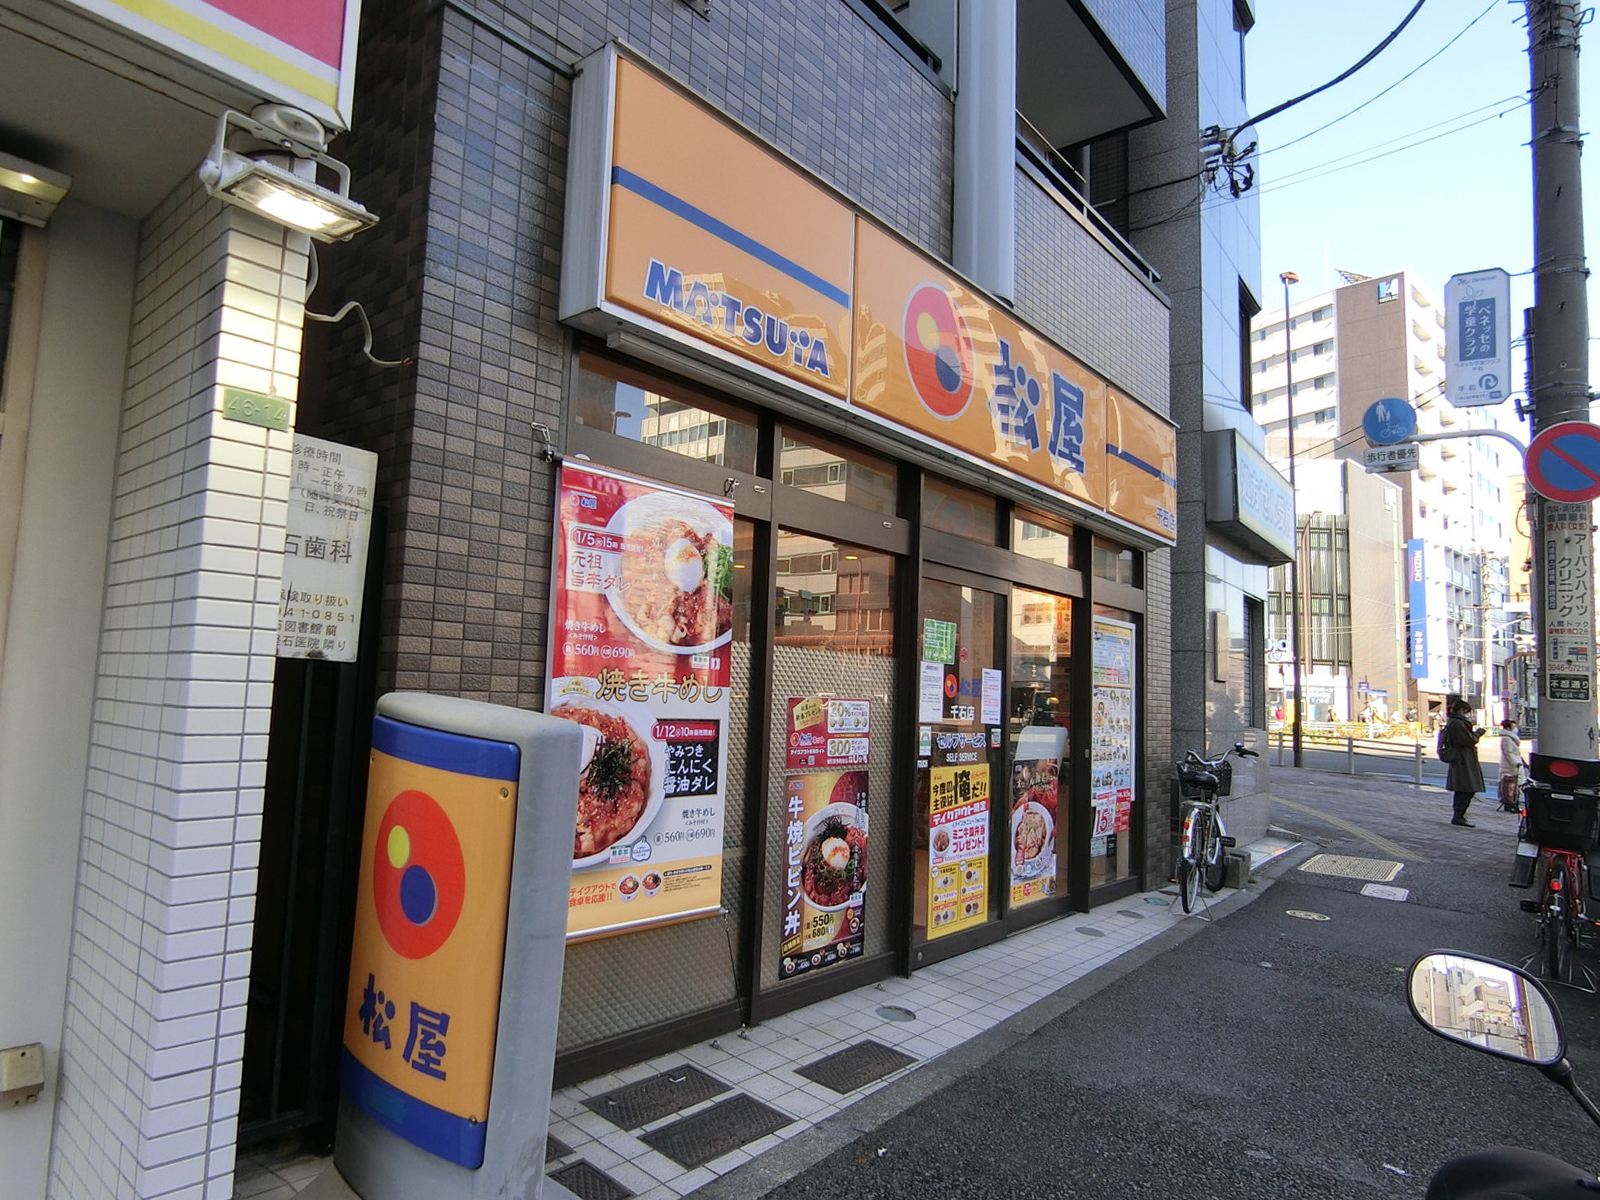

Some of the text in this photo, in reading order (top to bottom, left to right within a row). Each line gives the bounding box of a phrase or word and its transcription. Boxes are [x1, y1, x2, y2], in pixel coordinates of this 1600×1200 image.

[643, 257, 830, 378] MATSUYA
[1464, 305, 1477, 358] 学童クラブ
[1478, 305, 1491, 352] ベネッセの
[228, 396, 288, 424] 46-14
[986, 335, 1085, 476] 松屋
[1367, 448, 1417, 463] 歩行者優先
[286, 533, 352, 564] 石歯科
[571, 551, 603, 570] 元祖
[571, 569, 632, 592] 旨辛ダレ
[1574, 533, 1588, 616] アーバンハイツ
[1558, 556, 1573, 618] クリニック
[279, 608, 355, 623] 41-0851
[1549, 620, 1588, 628] 人間ドック
[565, 619, 606, 633] 焼き牛めし
[596, 667, 723, 703] 焼き牛めし
[950, 705, 975, 721] 千石店
[829, 740, 852, 756] 300
[937, 733, 988, 749] セルフサービス
[665, 744, 704, 758] やみつき
[946, 752, 978, 762] SELF SERVICE
[665, 758, 713, 776] にんにく
[664, 775, 716, 794] 醤油ダレ
[933, 781, 953, 796] 今度の
[953, 770, 971, 805] 俺
[933, 795, 953, 811] 主役は
[682, 807, 716, 819] 焼き牛めし
[933, 802, 986, 825] テイクアウト限定
[953, 836, 985, 854] プレゼント!
[784, 795, 804, 937] 牛焼ビビン丼
[569, 882, 617, 897] テイクアウトで
[569, 892, 613, 909] 食卓を応援!!
[359, 972, 450, 1081] 松屋
